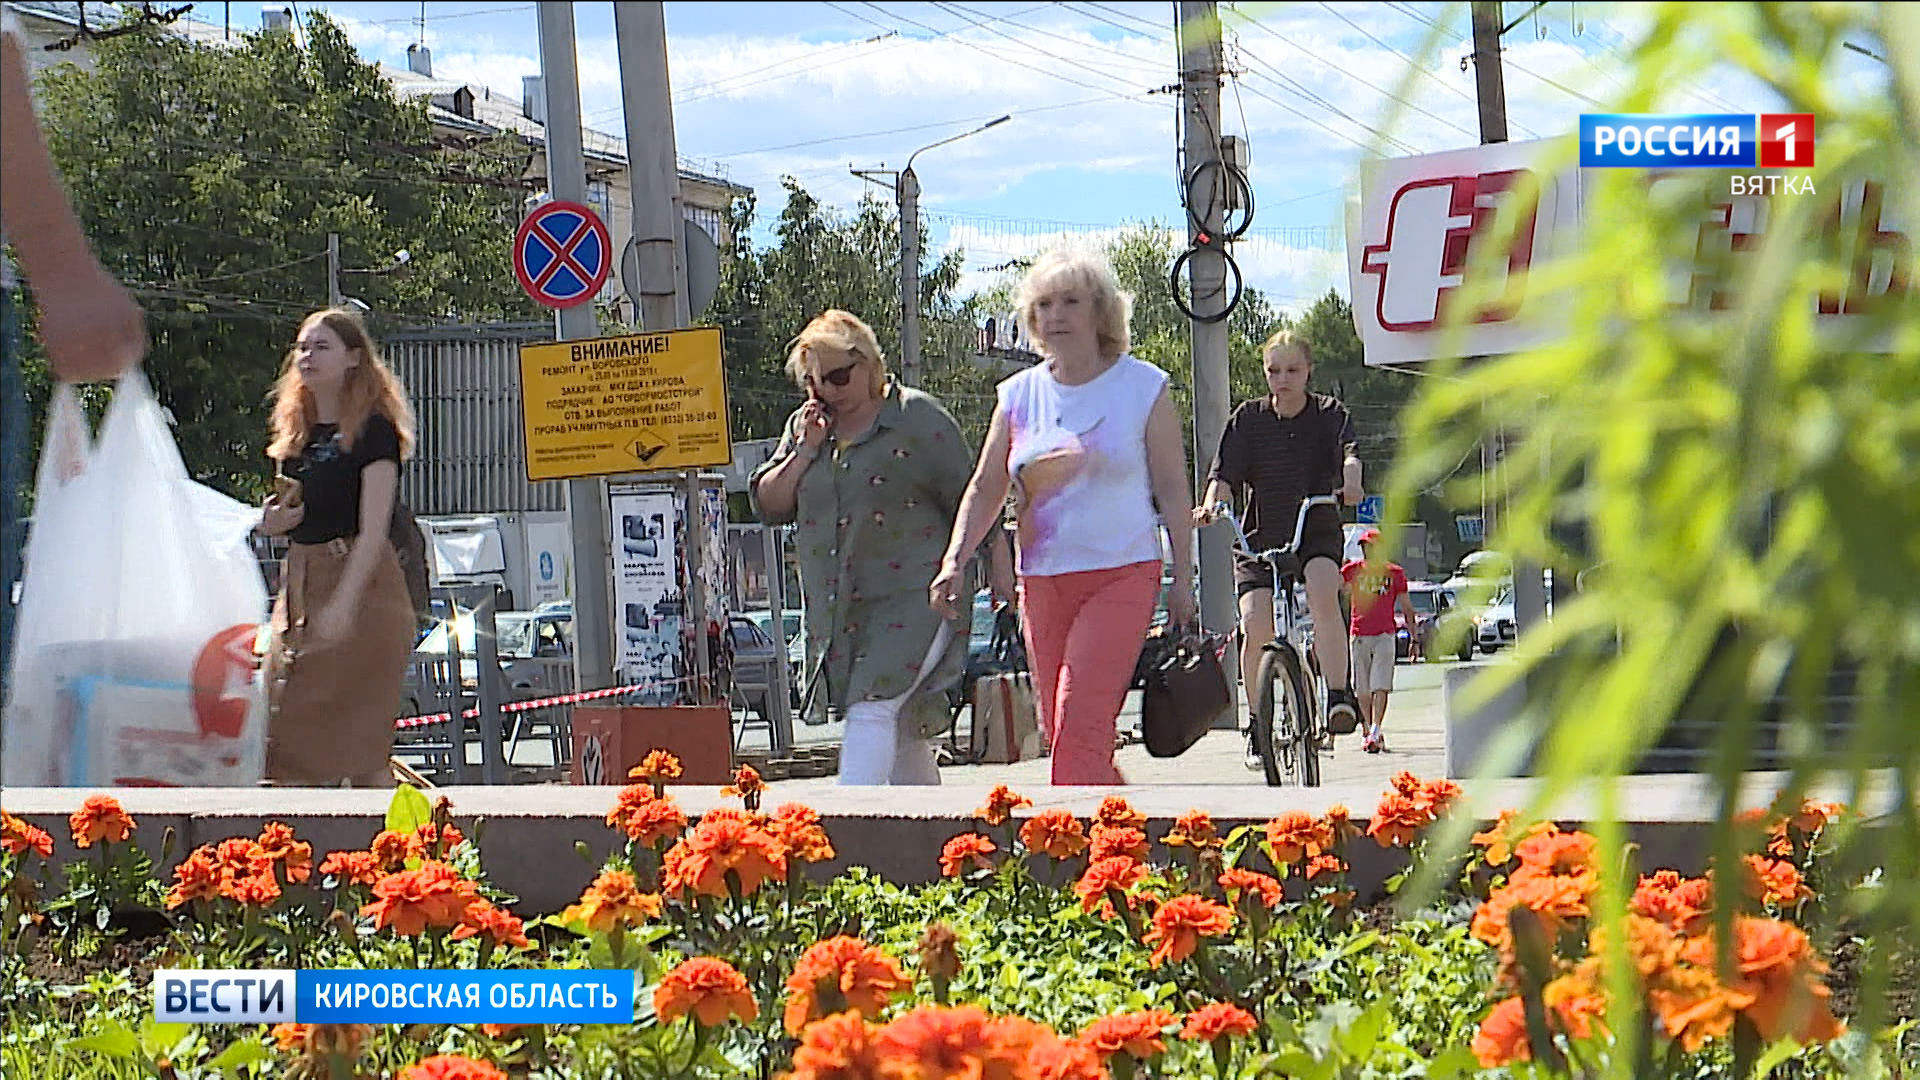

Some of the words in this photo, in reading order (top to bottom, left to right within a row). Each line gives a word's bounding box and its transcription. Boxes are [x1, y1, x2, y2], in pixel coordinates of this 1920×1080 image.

[571, 336, 670, 362] ВНИМАНИЕ!
[542, 365, 576, 376] РЕМОНТ
[652, 375, 685, 387] КИРОВА
[603, 394, 615, 404] АО
[597, 404, 652, 418] ВЫПОЛНЕНИЕ
[655, 402, 681, 413] РАБОТ
